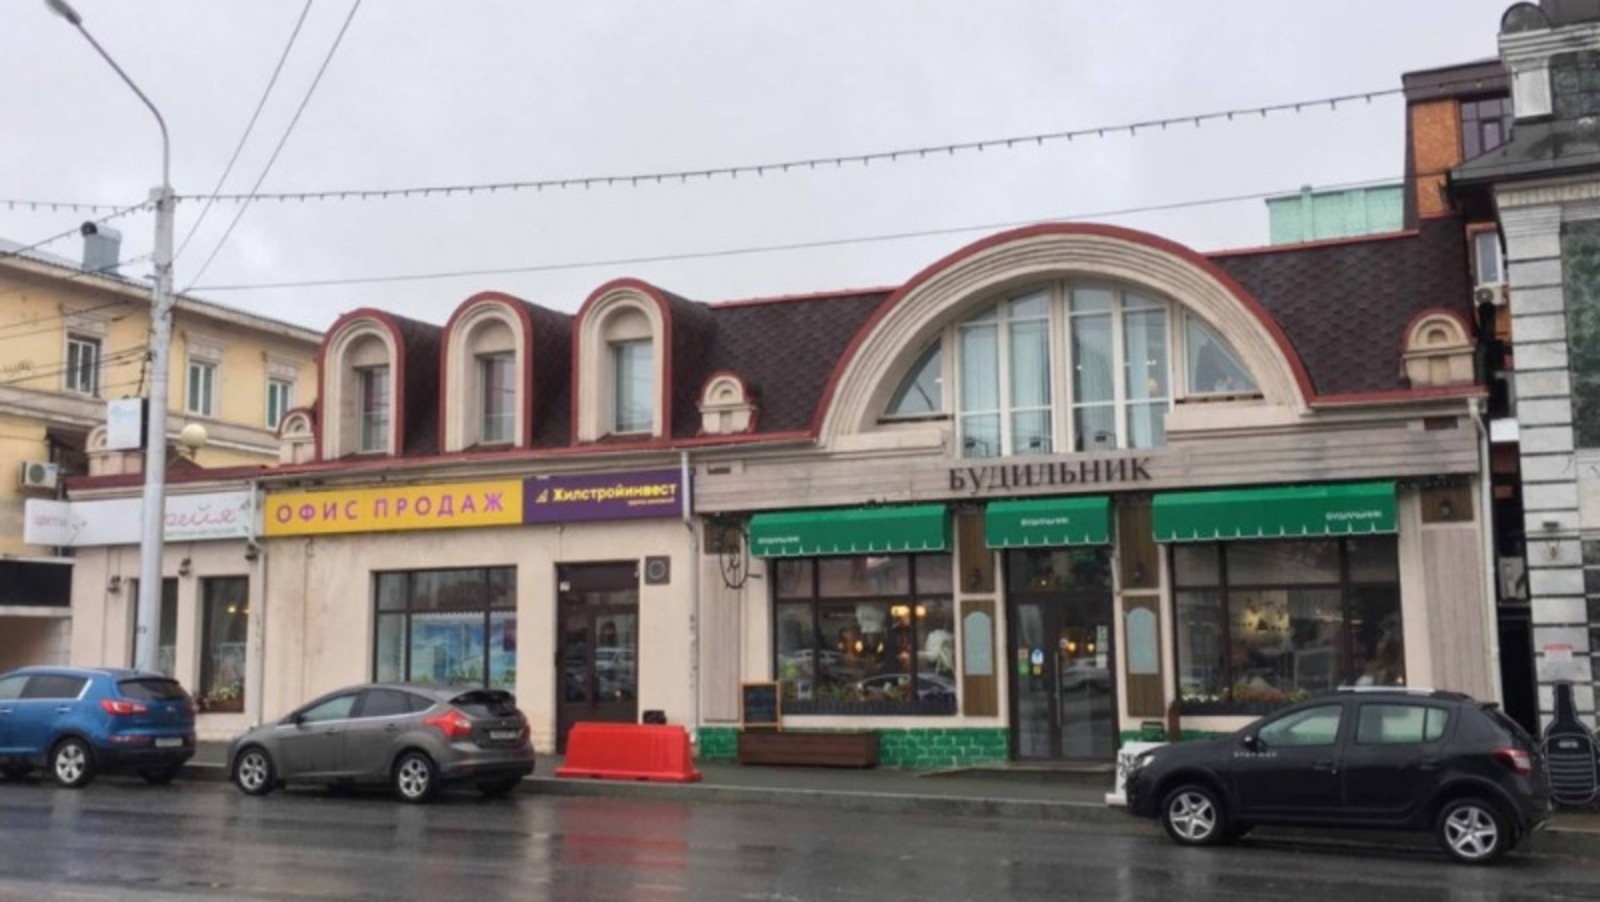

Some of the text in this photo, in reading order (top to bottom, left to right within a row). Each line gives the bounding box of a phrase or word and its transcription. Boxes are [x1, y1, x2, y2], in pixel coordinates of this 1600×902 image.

[949, 457, 1152, 494] БУДИЛЬНИК
[276, 492, 504, 523] ОФИС ПРОДАЖ
[553, 483, 677, 503] Жилстройинвест
